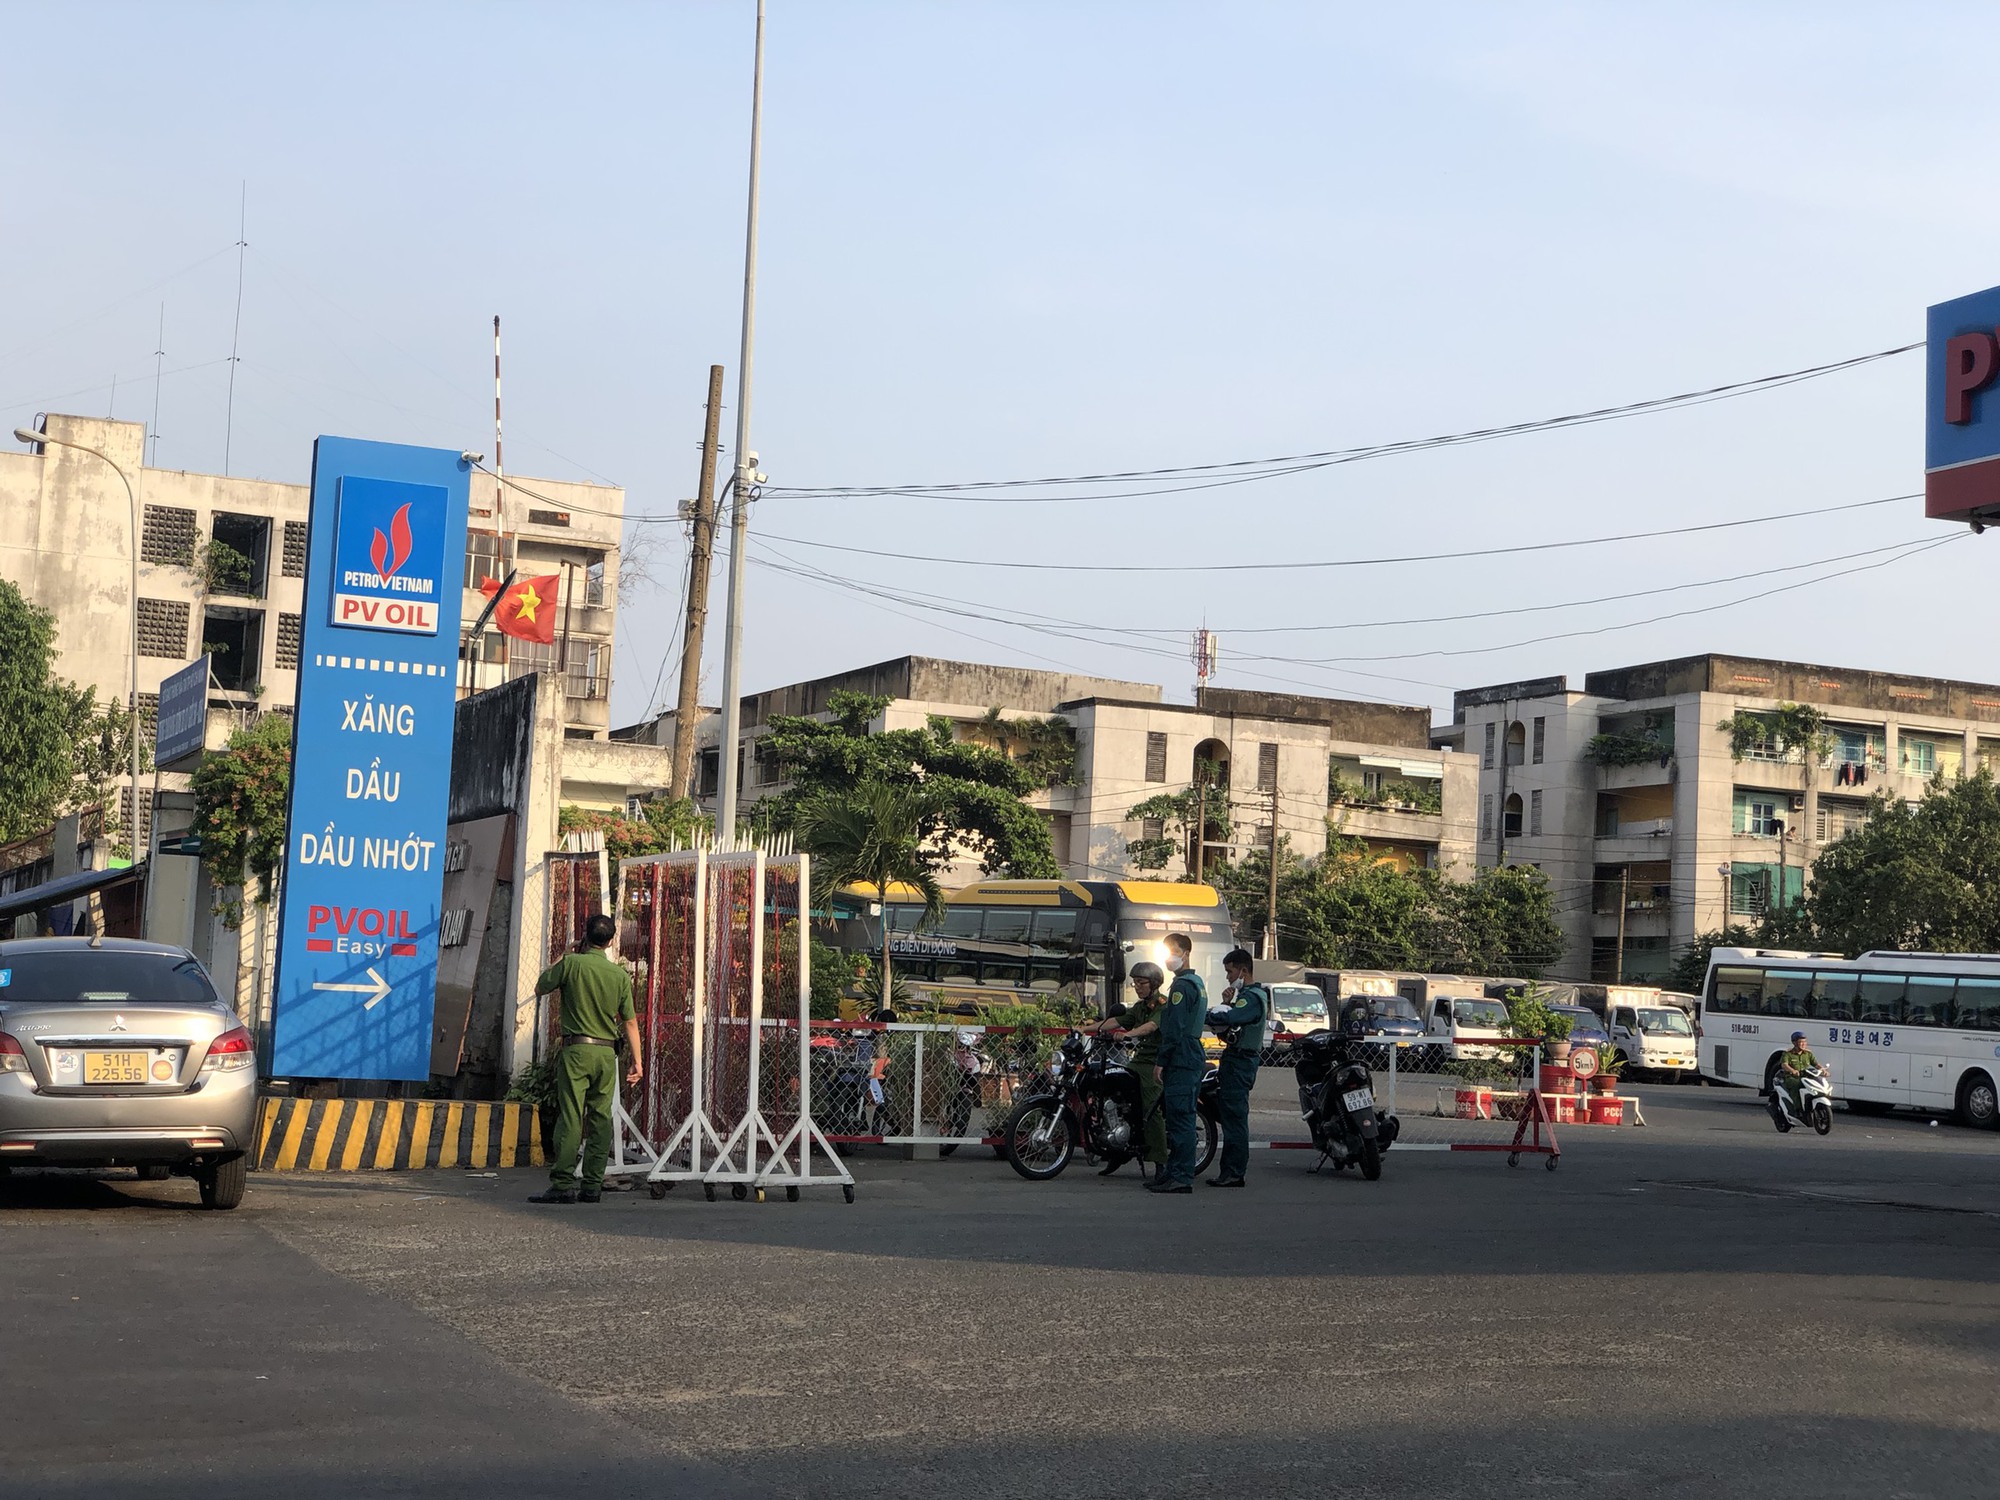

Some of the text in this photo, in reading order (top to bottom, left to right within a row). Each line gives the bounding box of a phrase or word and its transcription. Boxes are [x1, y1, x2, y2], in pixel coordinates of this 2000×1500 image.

[1944, 324, 2000, 425] P
[344, 571, 434, 594] PETROVIETNAM
[343, 599, 430, 627] PV OIL
[341, 693, 415, 736] XĂNG
[346, 757, 401, 802] DẦU
[300, 821, 355, 867] DẦU
[363, 832, 436, 871] NHỚT
[308, 904, 418, 939] PVOIL
[336, 937, 387, 959] Easy
[930, 938, 957, 957] ĐỘNG
[92, 1068, 142, 1081] 225.56
[103, 1054, 131, 1067] 51H
